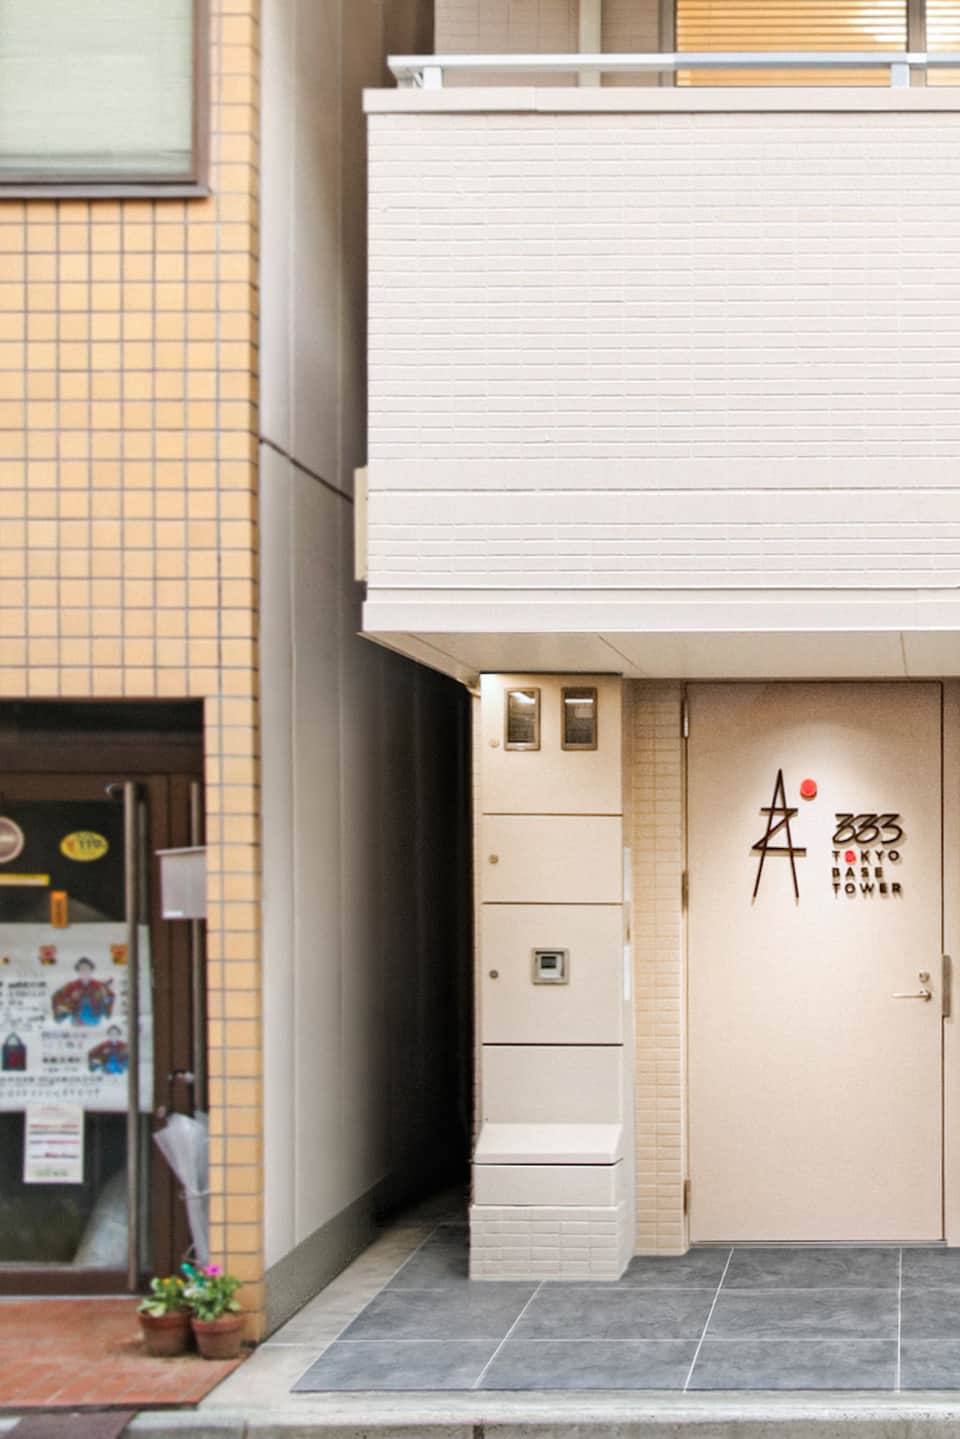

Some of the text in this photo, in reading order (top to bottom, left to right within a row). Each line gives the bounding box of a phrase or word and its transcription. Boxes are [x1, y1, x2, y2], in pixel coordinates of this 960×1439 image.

[832, 813, 903, 844] 333
[831, 849, 901, 863] TOKYO
[831, 866, 883, 879] BASE
[831, 882, 902, 895] TOWER
